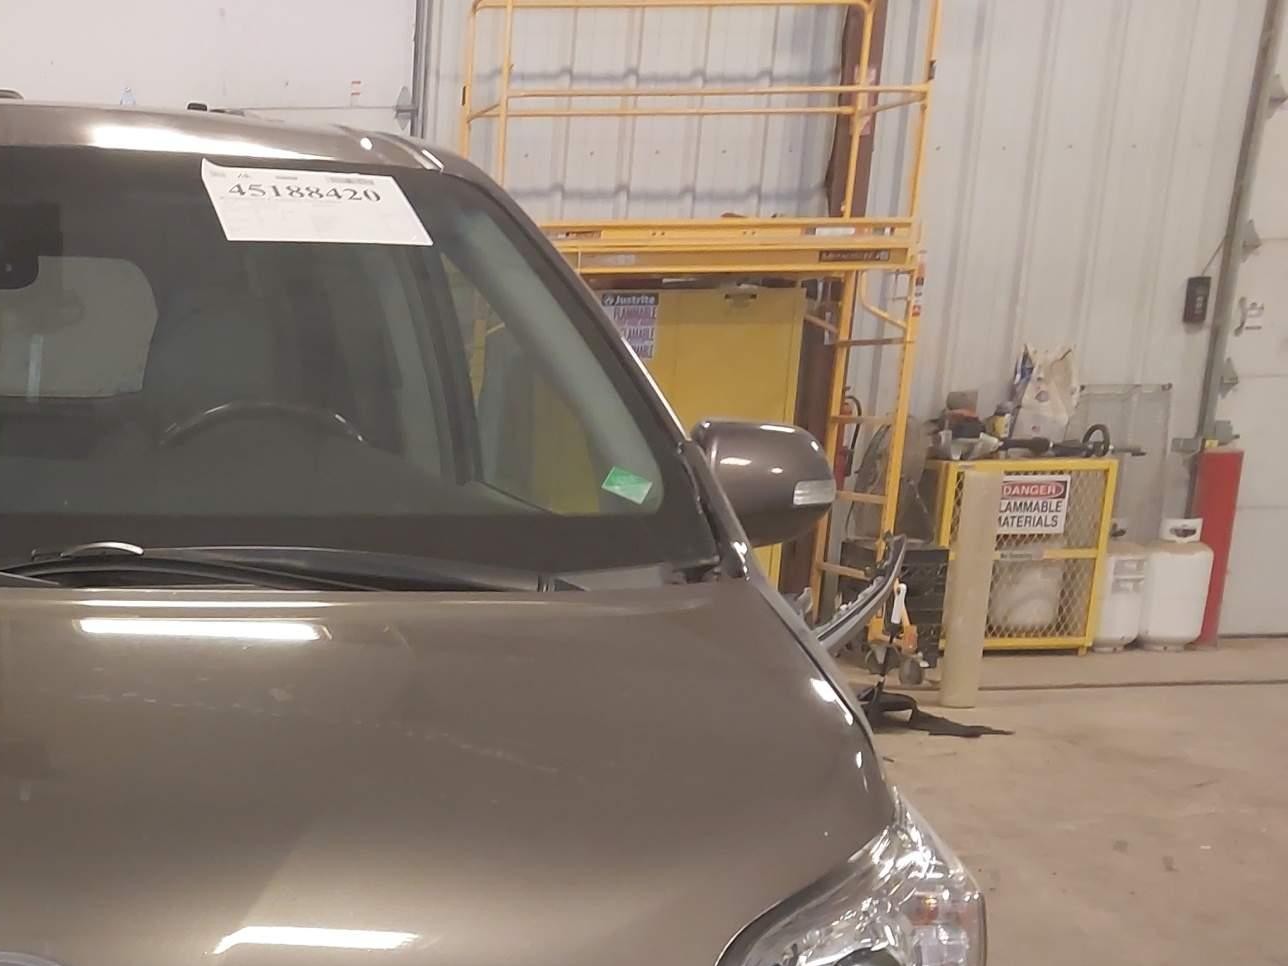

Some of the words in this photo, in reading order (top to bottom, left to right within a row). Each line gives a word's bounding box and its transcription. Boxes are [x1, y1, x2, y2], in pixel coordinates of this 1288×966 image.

[229, 183, 381, 202] 45188420
[1004, 485, 1056, 496] DANGER
[1000, 501, 1062, 512] LAMMABLE
